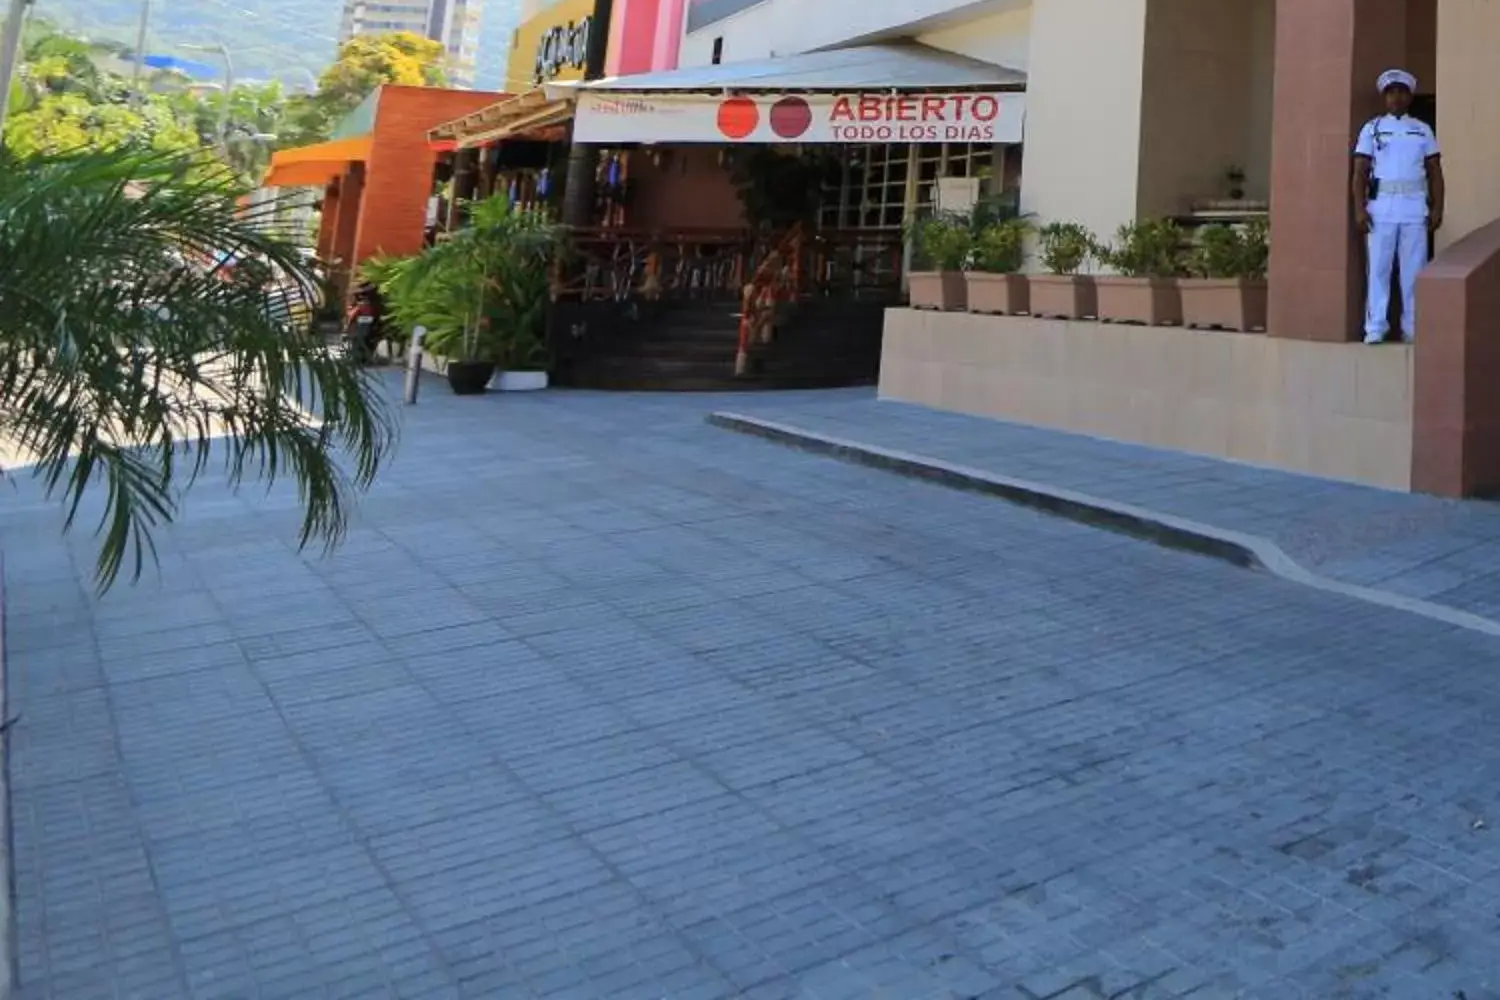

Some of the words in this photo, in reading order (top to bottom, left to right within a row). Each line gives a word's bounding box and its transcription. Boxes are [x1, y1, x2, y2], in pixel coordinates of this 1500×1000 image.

[829, 95, 999, 121] ABIERTO
[832, 125, 892, 140] TODO
[900, 125, 937, 140] LOS
[945, 125, 994, 140] DIAS
